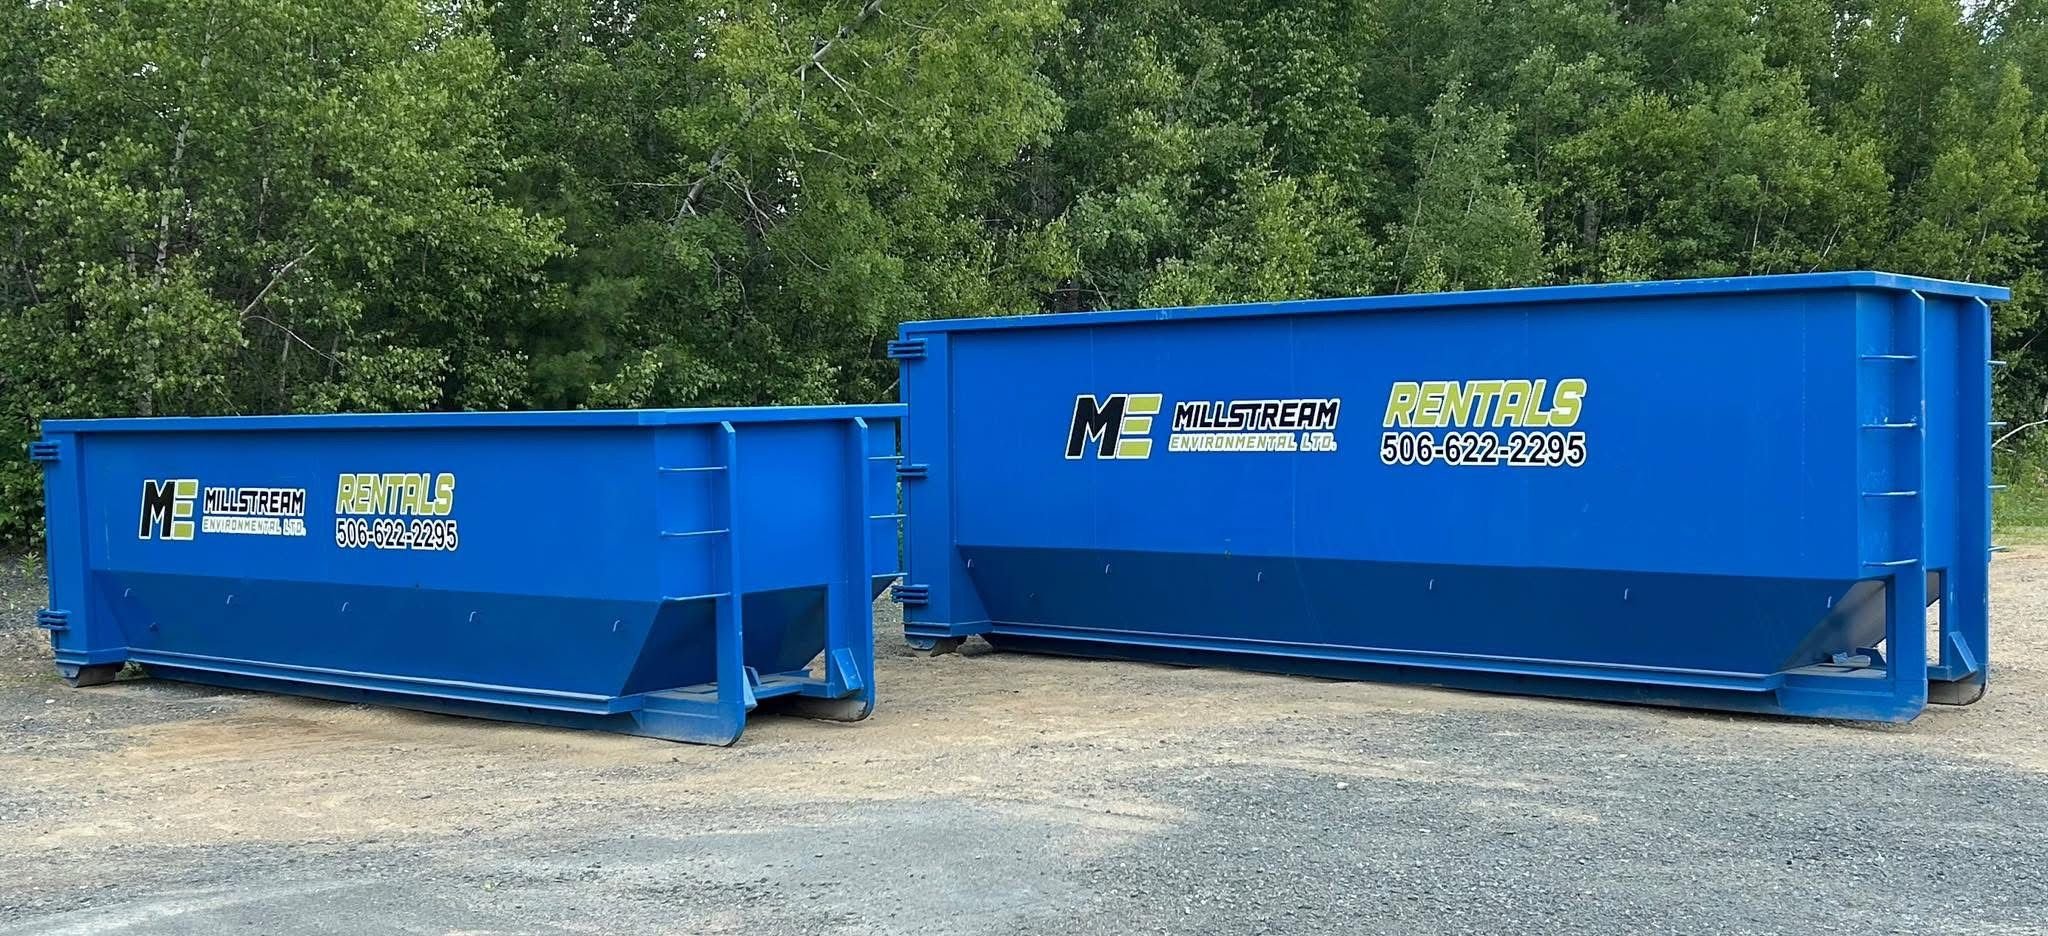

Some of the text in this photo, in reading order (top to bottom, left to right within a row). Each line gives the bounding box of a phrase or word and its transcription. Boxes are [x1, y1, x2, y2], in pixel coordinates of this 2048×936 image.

[1175, 401, 1338, 430] MILLSTREAM
[1385, 380, 1586, 427] RENTALS
[1170, 434, 1337, 451] ENVIRONMENTAL LTD.
[1382, 433, 1585, 464] 506-622-2295
[204, 488, 305, 514] MILLSTREAM
[337, 474, 455, 514] RENTALS
[203, 517, 307, 536] ENVIRONMENTAL LTD.
[336, 520, 457, 550] 506-622-2295
